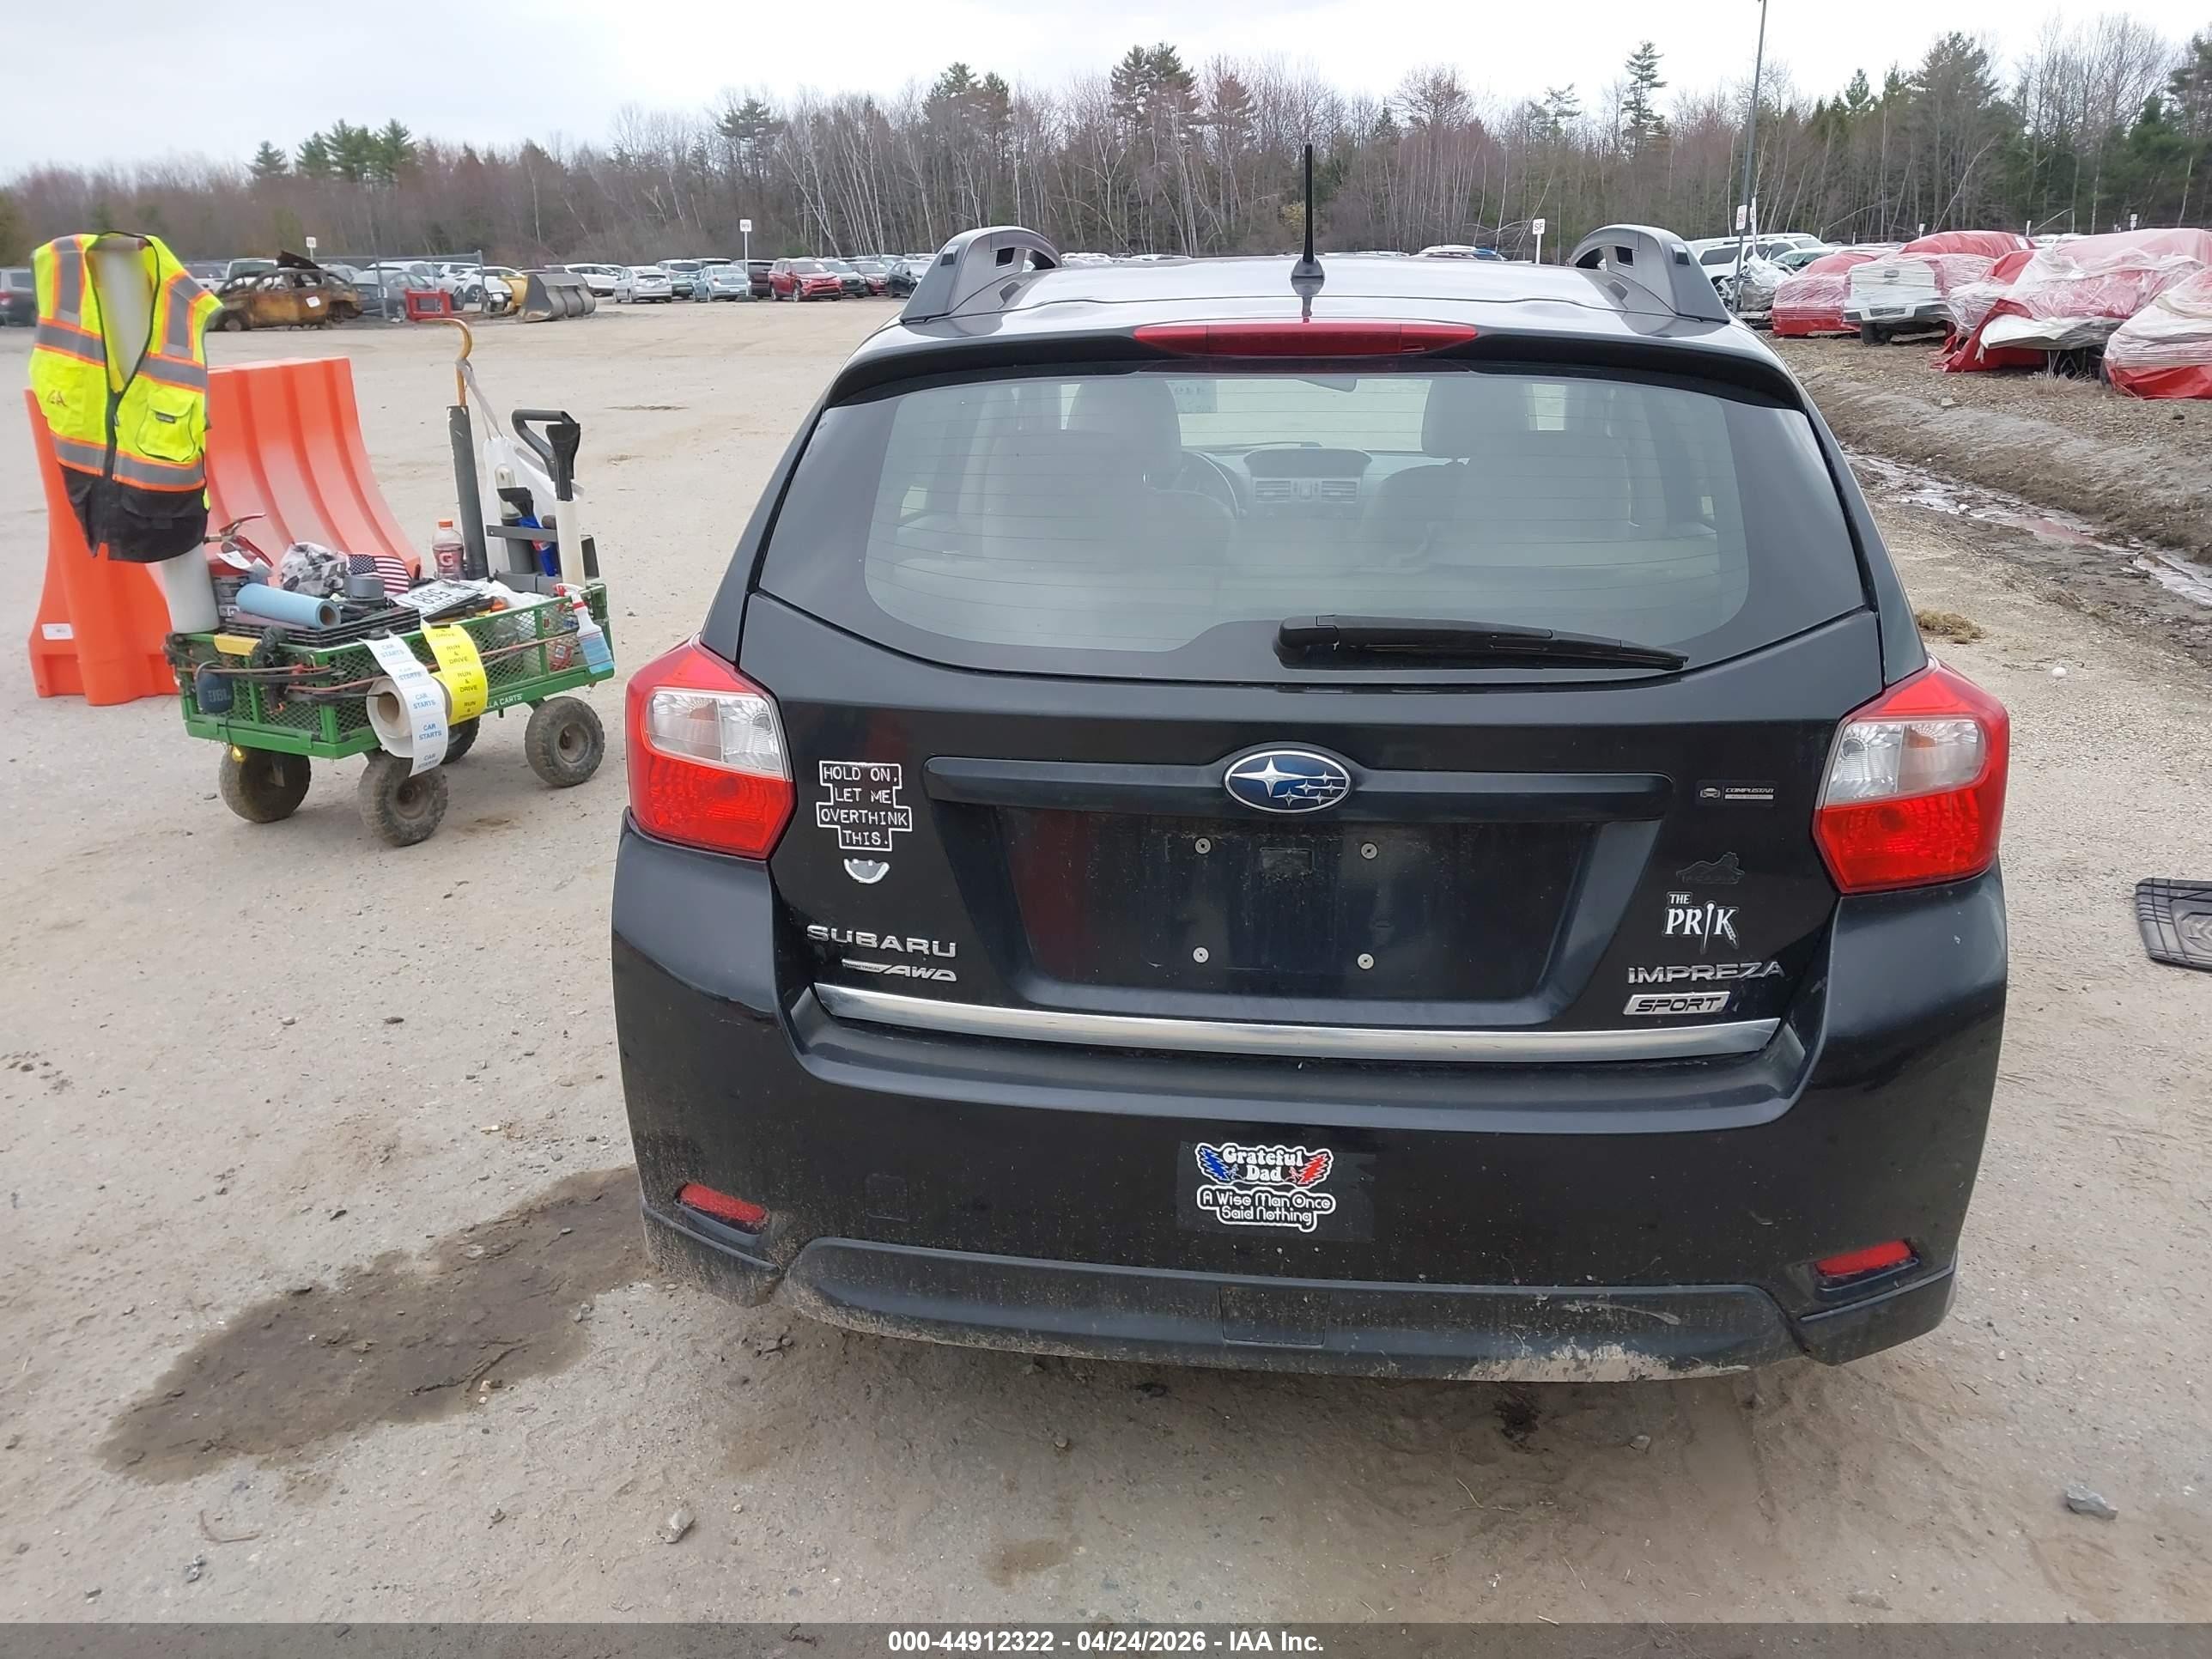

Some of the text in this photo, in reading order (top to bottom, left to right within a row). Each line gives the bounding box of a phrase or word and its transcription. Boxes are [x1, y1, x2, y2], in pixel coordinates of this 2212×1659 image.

[448, 656, 468, 665] DRIVE
[459, 684, 478, 693] DRIVE
[412, 700, 436, 709] STARTS
[499, 693, 523, 705] CARTS
[422, 722, 436, 731] CAR
[418, 730, 442, 740] STARTS
[823, 765, 861, 781] HOLD
[834, 788, 892, 804] LET ME
[820, 808, 908, 826] OVERTHINK
[842, 830, 890, 846] THIS.
[1668, 894, 1691, 904] THE
[806, 925, 957, 958] SUBARU
[883, 964, 957, 981] AWD
[1628, 961, 1786, 984] IMPREZA
[1634, 996, 1723, 1012] SPORT
[1222, 1147, 1304, 1167] Grateful
[1245, 1165, 1283, 1182] Dad
[1202, 1190, 1331, 1209] A Wise Man Once
[1221, 1205, 1312, 1224] Said Nothing
